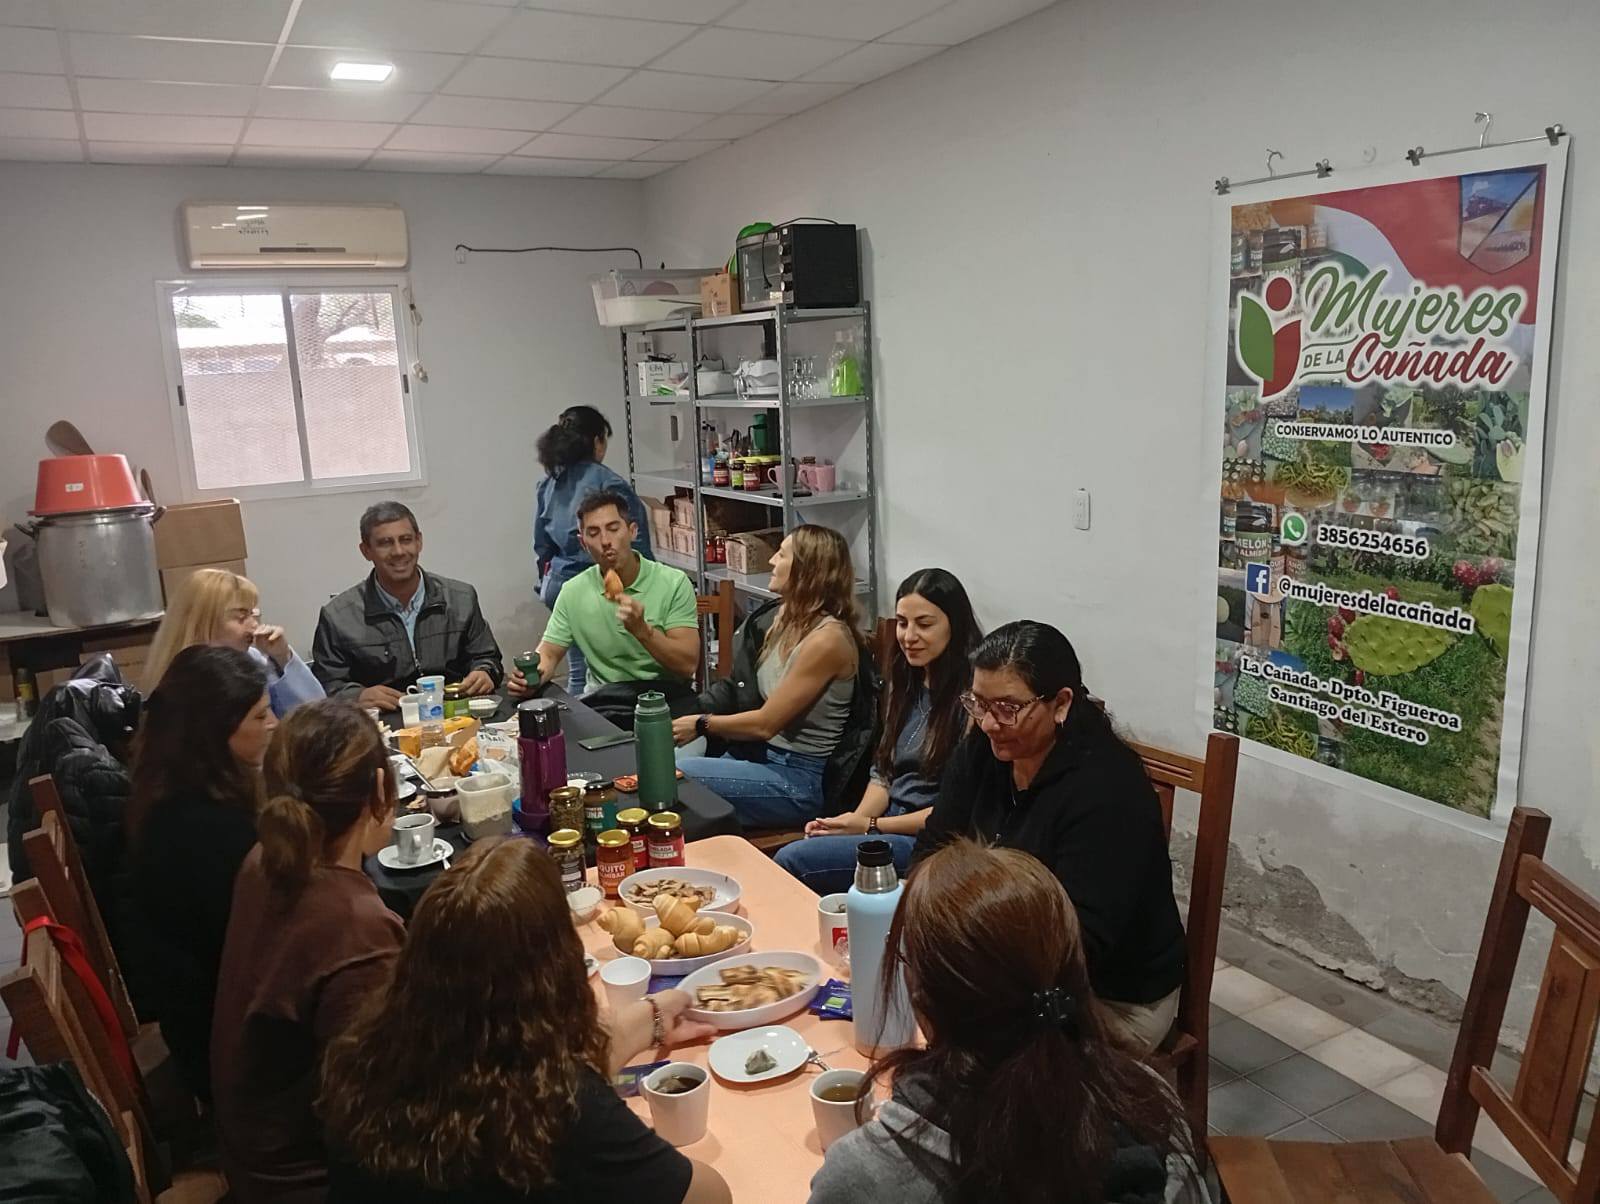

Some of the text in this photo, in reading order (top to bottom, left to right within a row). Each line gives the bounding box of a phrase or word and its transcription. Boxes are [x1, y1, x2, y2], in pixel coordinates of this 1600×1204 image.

[1305, 266, 1523, 349] Mujeres
[1303, 348, 1344, 369] DE LA
[1345, 332, 1513, 385] Cañada
[1276, 424, 1453, 446] CONSERVAMOS LO AUTENTICO
[1318, 526, 1427, 557] 3856254656
[1279, 577, 1472, 631] @mujeresdelacañada
[1242, 658, 1259, 674] La
[1263, 663, 1319, 689] Cañada
[1331, 680, 1376, 706] Dpto.
[1380, 693, 1459, 729] Figueroa
[1269, 686, 1427, 742] Santiago del Estero
